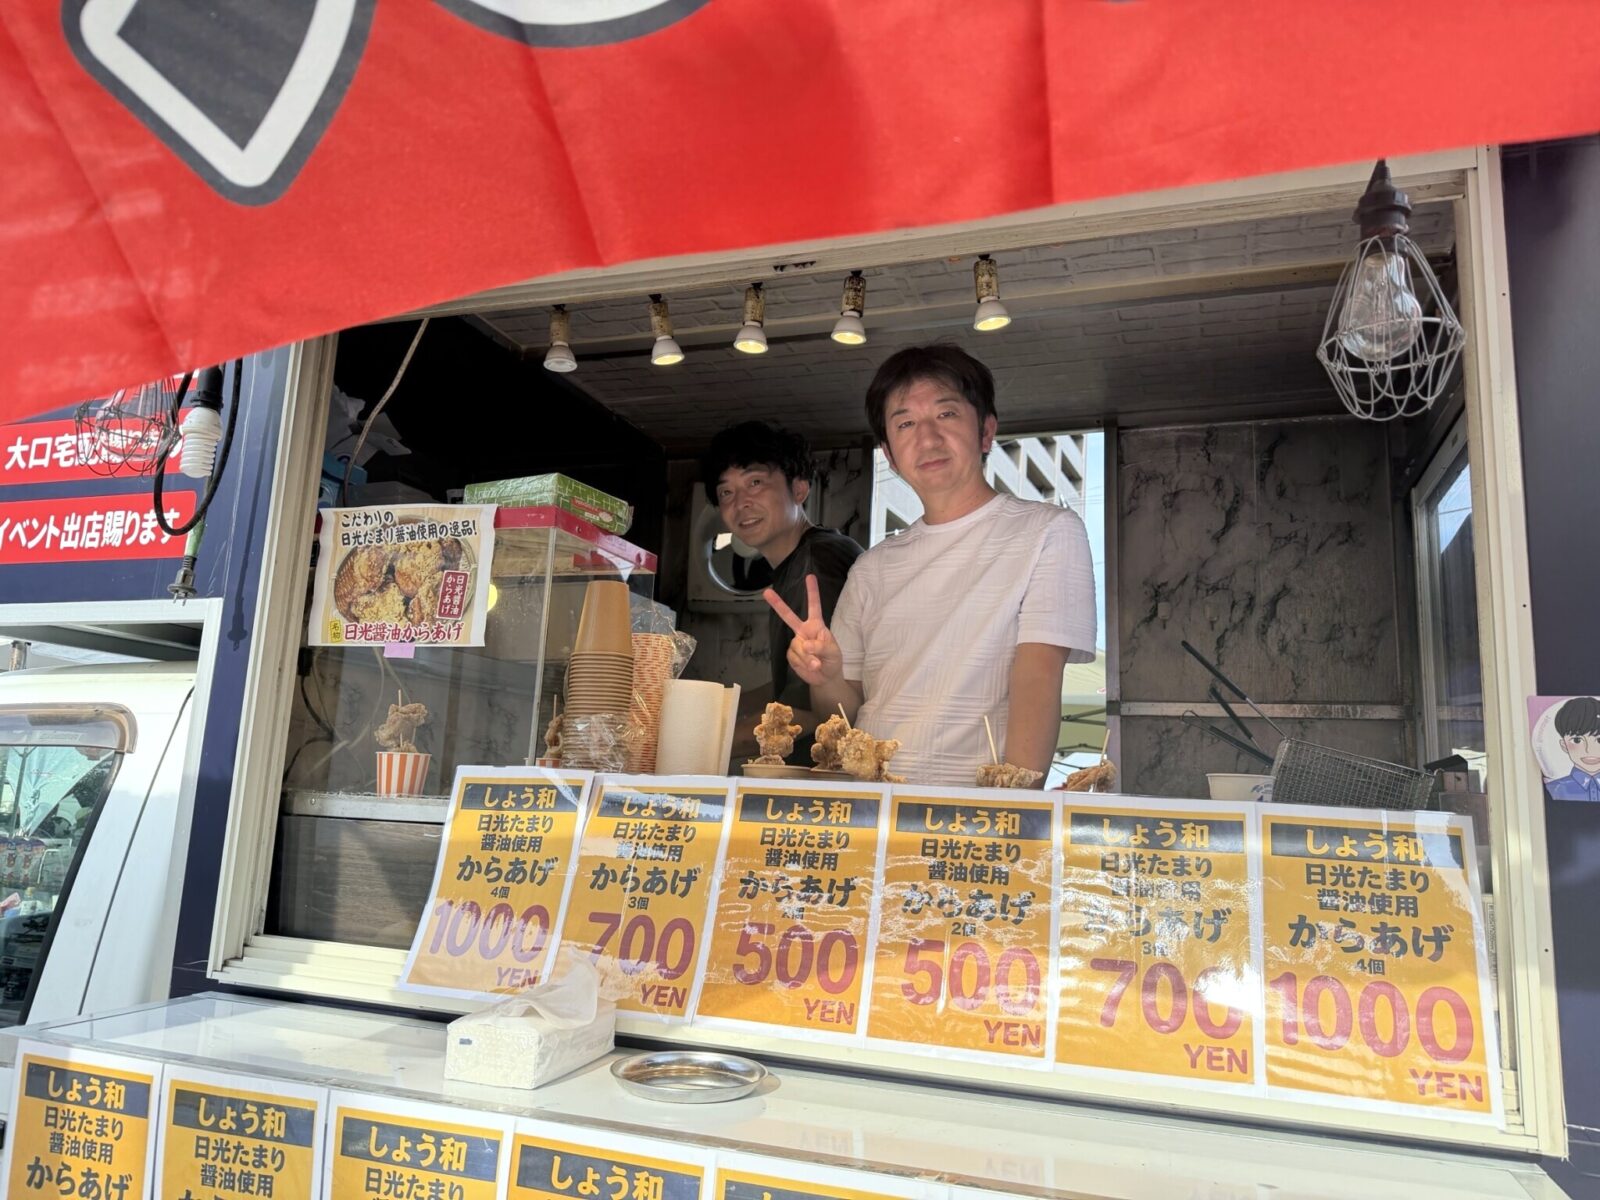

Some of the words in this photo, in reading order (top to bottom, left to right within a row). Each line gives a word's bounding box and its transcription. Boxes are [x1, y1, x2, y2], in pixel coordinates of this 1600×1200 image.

[341, 510, 394, 527] こだわりの
[441, 574, 456, 615] からあげ
[344, 622, 465, 642] 日光醤油からあげ
[483, 786, 557, 810] しょう和
[622, 796, 702, 819] しょう和
[766, 798, 852, 824] しょう和
[477, 813, 554, 834] 日光たまり
[613, 822, 697, 842] 日光たまり
[924, 808, 1021, 835] しょう和
[1103, 819, 1210, 849] しょう和
[480, 833, 542, 853] 醤油使用
[616, 841, 684, 863] 醤油使用
[760, 827, 850, 850] 日光たまり
[921, 838, 1022, 863] 日光たまり
[1305, 829, 1424, 862] しょう和
[456, 855, 558, 886] からあげ
[764, 848, 839, 871] 醤油使用
[928, 862, 1010, 886] 醤油使用
[1100, 851, 1213, 879] 日光たまり
[490, 887, 510, 899] 4個
[589, 863, 701, 898] からあげ
[737, 870, 857, 908] からあげ
[1305, 863, 1430, 893] 日光たまり
[627, 896, 649, 910] 3個
[901, 884, 1036, 925] からあげ
[1317, 889, 1419, 918] 醤油使用
[428, 899, 550, 964] 1000
[951, 922, 976, 937] 2個
[1084, 902, 1232, 943] らあげ
[1289, 914, 1455, 962] からあげ
[588, 911, 696, 981] 700
[732, 922, 859, 994] 500
[495, 966, 540, 990] YEN
[900, 938, 1041, 1016] 500
[639, 984, 687, 1009] YEN
[803, 998, 856, 1026] YEN
[1089, 957, 1244, 1040] 700
[1268, 970, 1475, 1065] 1000
[983, 1020, 1042, 1048] YEN
[1184, 1043, 1249, 1074] YEN
[48, 1070, 126, 1110] しょう和
[1408, 1068, 1484, 1102] YEN
[44, 1106, 124, 1141] 日光たまり
[198, 1097, 288, 1138] しょう和
[49, 1132, 114, 1165] 醤油使用
[194, 1135, 286, 1173] 日光たまり
[368, 1126, 468, 1172] しょう和
[26, 1156, 133, 1200] からあげ
[200, 1163, 274, 1198] 醤油使用
[365, 1166, 464, 1200] 日光たまり
[550, 1155, 664, 1200] しょう和
